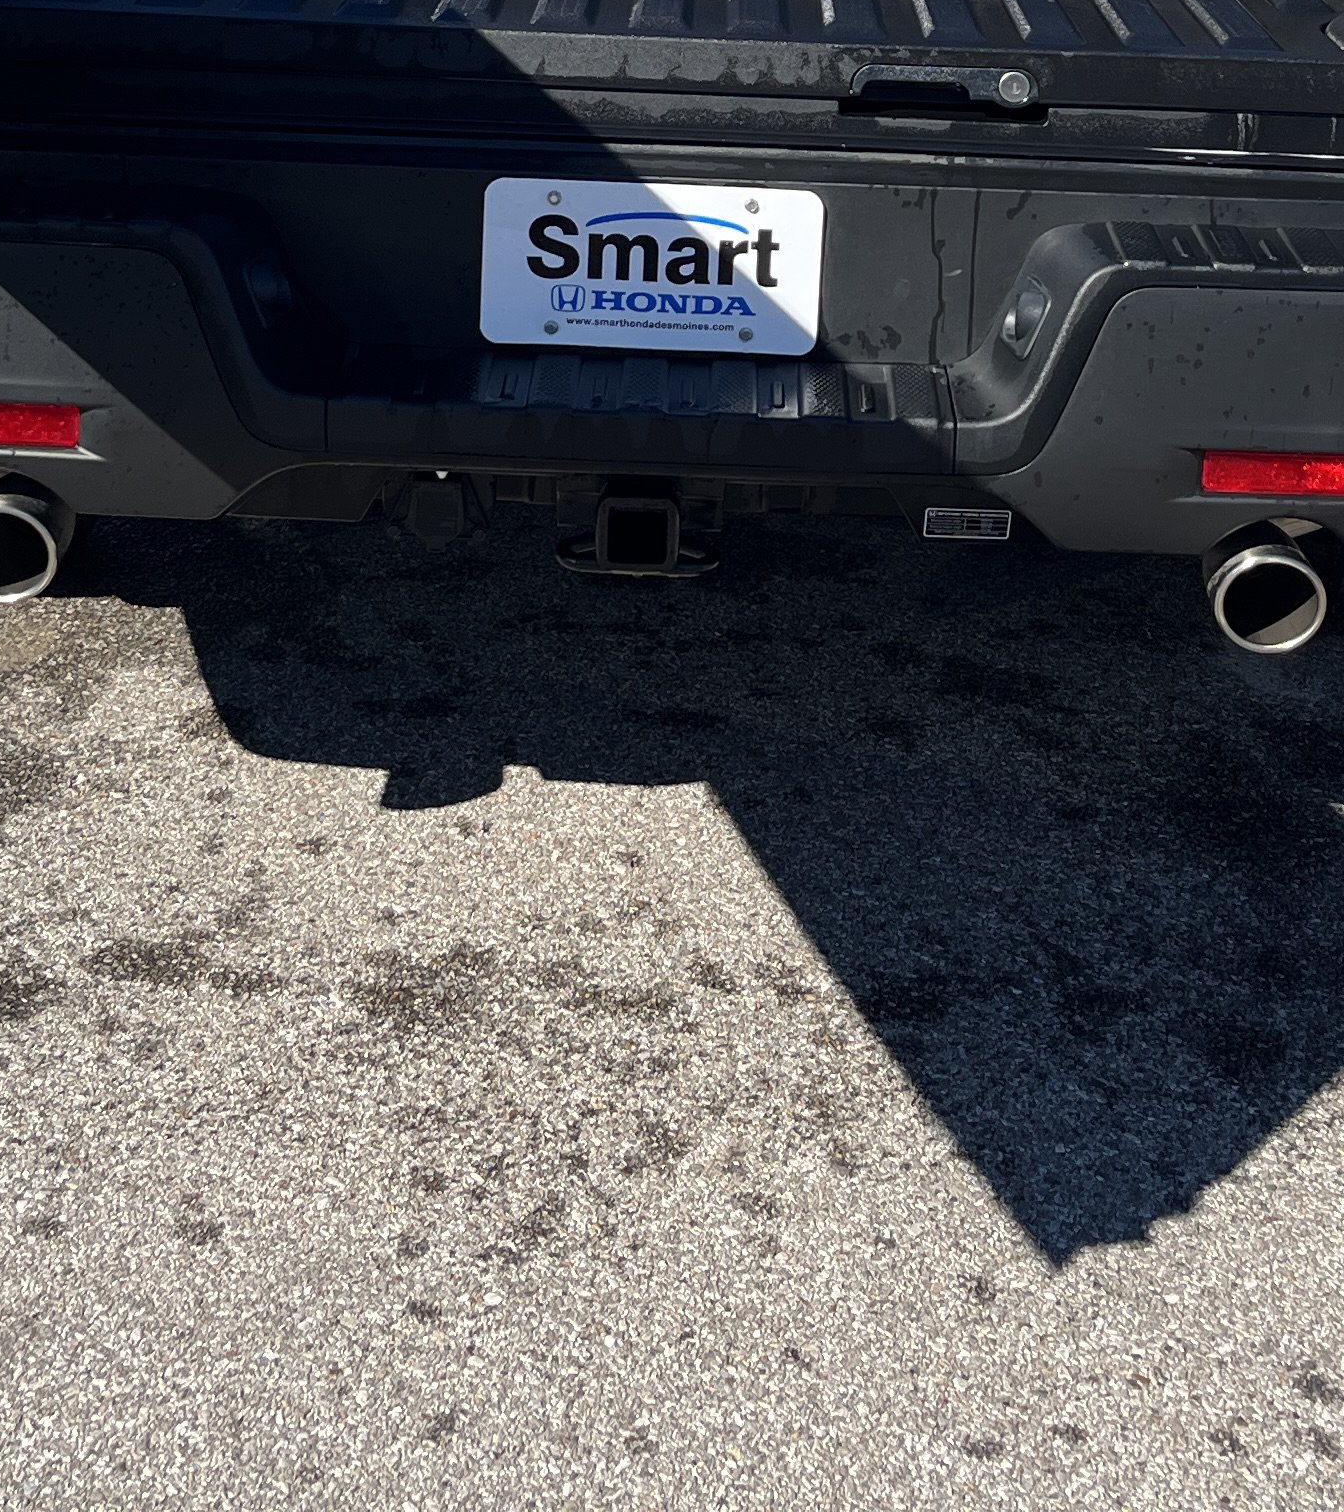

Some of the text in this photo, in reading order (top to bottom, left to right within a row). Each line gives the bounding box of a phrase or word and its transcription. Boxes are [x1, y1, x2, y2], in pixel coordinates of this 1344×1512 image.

[526, 214, 780, 288] Smart
[591, 289, 756, 316] HONDA
[566, 317, 735, 332] www.smarthondadesmoines.com
